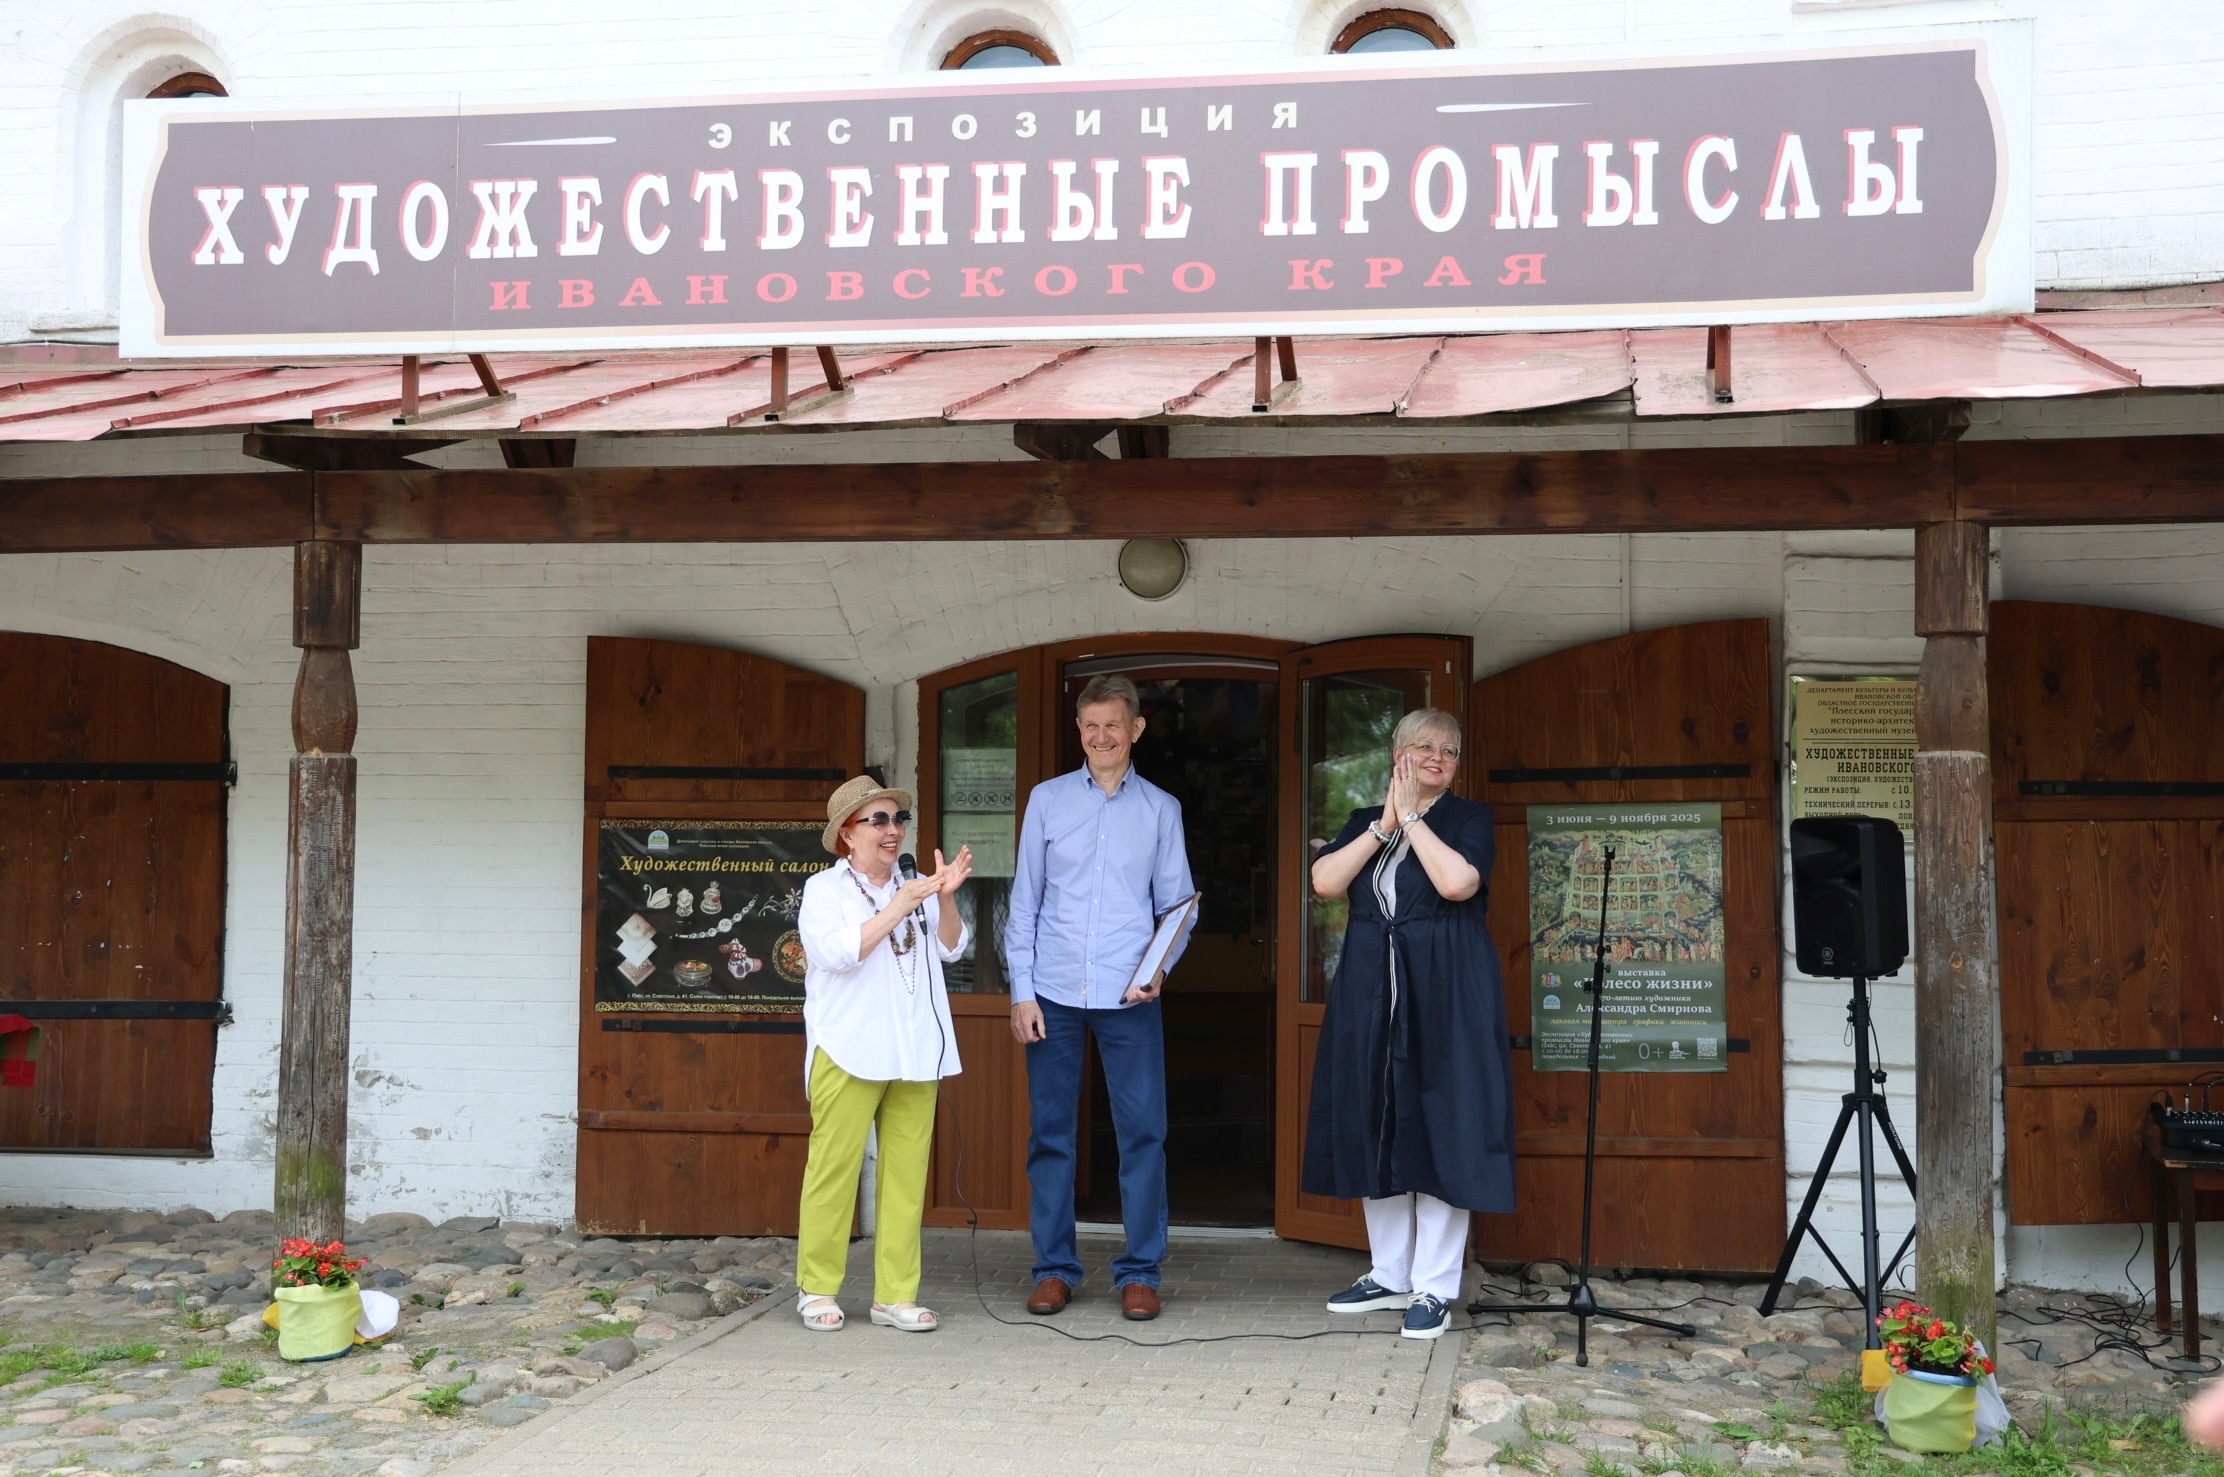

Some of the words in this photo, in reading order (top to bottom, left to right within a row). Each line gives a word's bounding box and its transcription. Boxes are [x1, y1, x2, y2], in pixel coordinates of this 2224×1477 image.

[706, 101, 1299, 151] ЭКСПОЗИЦИЯ
[191, 150, 1194, 277] ХУДОЖЕСТВЕННЫЕ
[1260, 125, 1924, 238] ПРОМЫСЛЫ
[488, 260, 1217, 312] ИВАНОВСКОГО
[1287, 253, 1547, 291] КРАЯ
[1878, 708, 1914, 717] государ
[1830, 718, 1914, 726] историко-архитек
[1809, 727, 1888, 735] художественный
[1805, 748, 1914, 760] ХУДОЖЕСТВЕННЫЕ
[1898, 785, 1912, 794] 10.
[1804, 800, 1855, 808] ТЕХНИЧЕСКИЙ
[1899, 799, 1913, 808] 13.
[1546, 815, 1554, 825] 3
[1557, 815, 1592, 824] июня
[1609, 815, 1617, 824] 9
[1620, 813, 1667, 824] ноября
[1670, 813, 1701, 823] 2025
[1898, 812, 1913, 820] ПОН
[619, 856, 775, 875] Художественный
[780, 861, 829, 873] салон
[1617, 969, 1666, 977] выставка
[1573, 977, 1642, 989] «лесо
[1645, 979, 1713, 990] жизни»
[1643, 994, 1691, 1003] художника
[1649, 1003, 1712, 1015] Смирнова
[1632, 1018, 1664, 1026] графика
